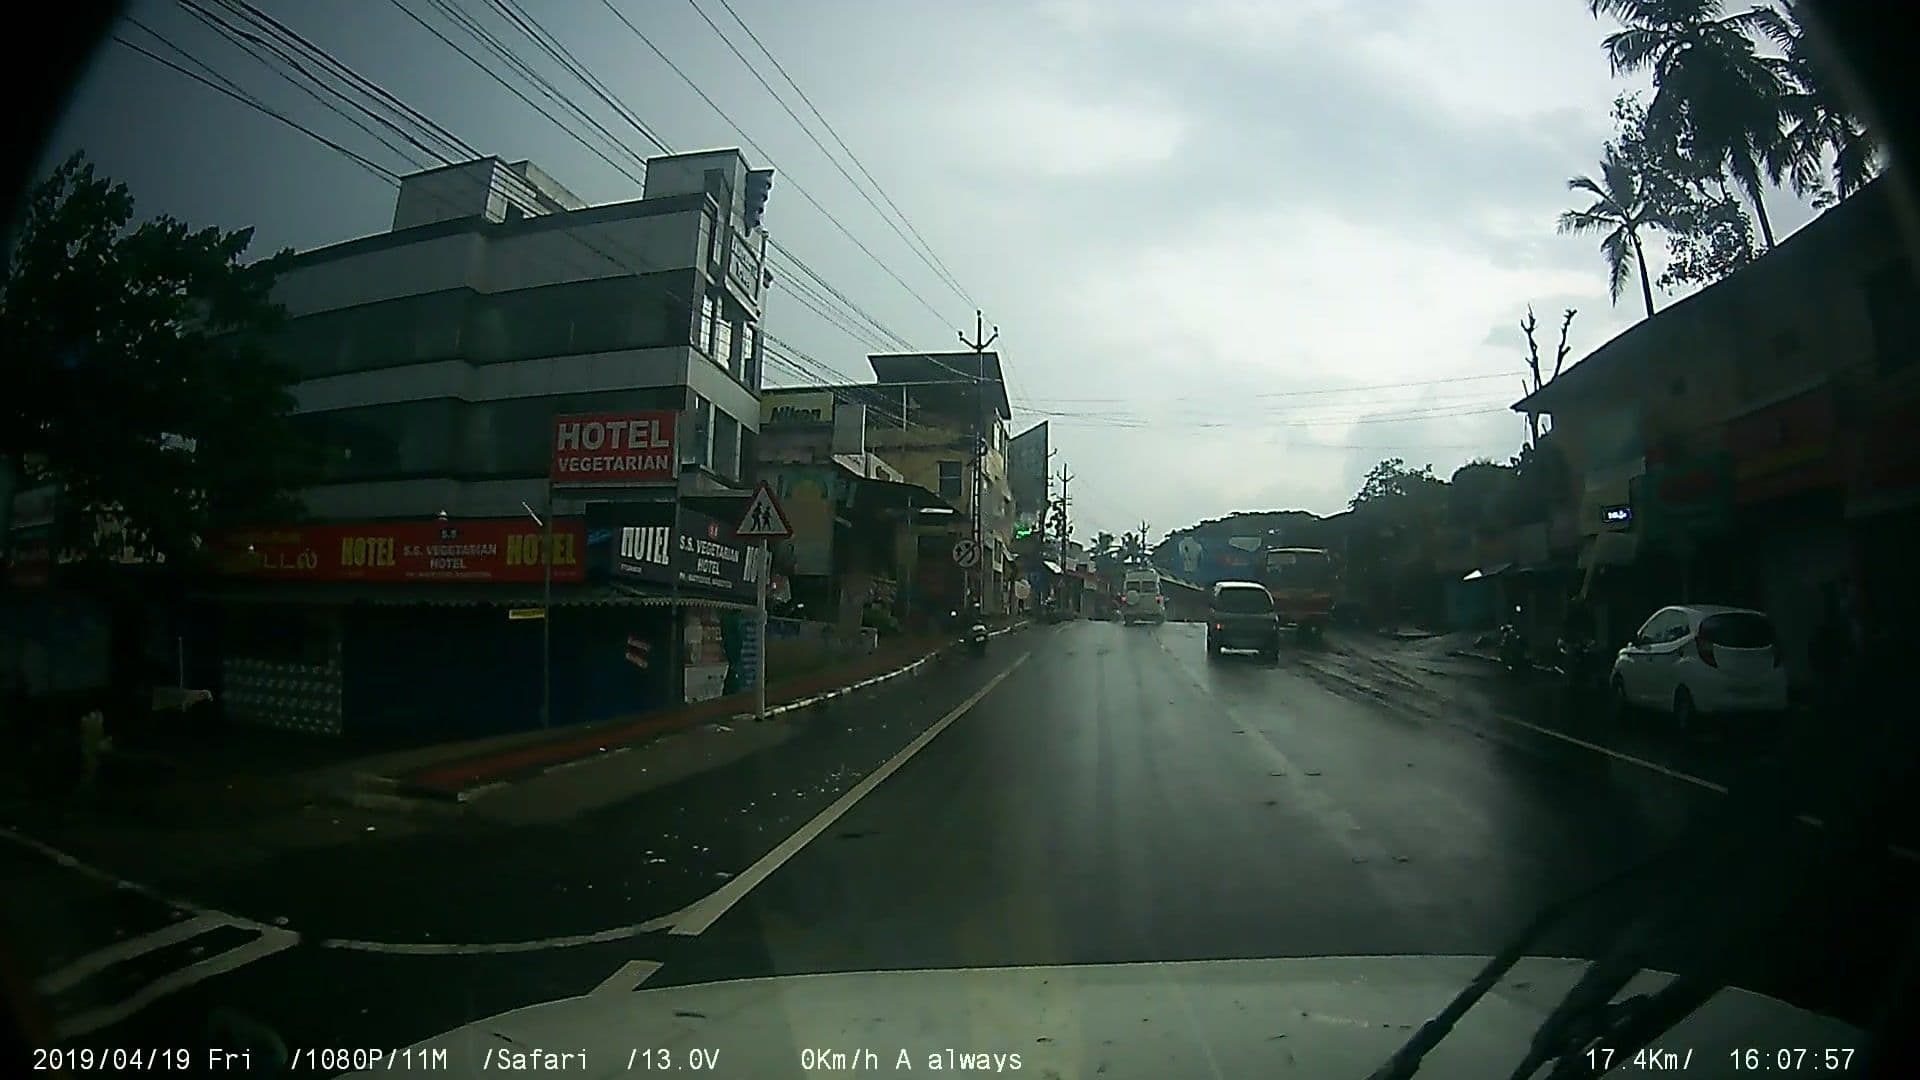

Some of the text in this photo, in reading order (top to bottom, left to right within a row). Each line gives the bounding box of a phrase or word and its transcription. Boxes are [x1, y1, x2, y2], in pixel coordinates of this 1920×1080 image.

[557, 419, 670, 451] HOTEL
[558, 454, 669, 472] VEGETARIAN
[340, 536, 396, 567] HOTEL
[426, 543, 497, 557] VEGETARIAN
[696, 539, 740, 563] VEGETARIAN
[430, 557, 466, 569] HOTEL
[697, 558, 720, 576] HOTEL
